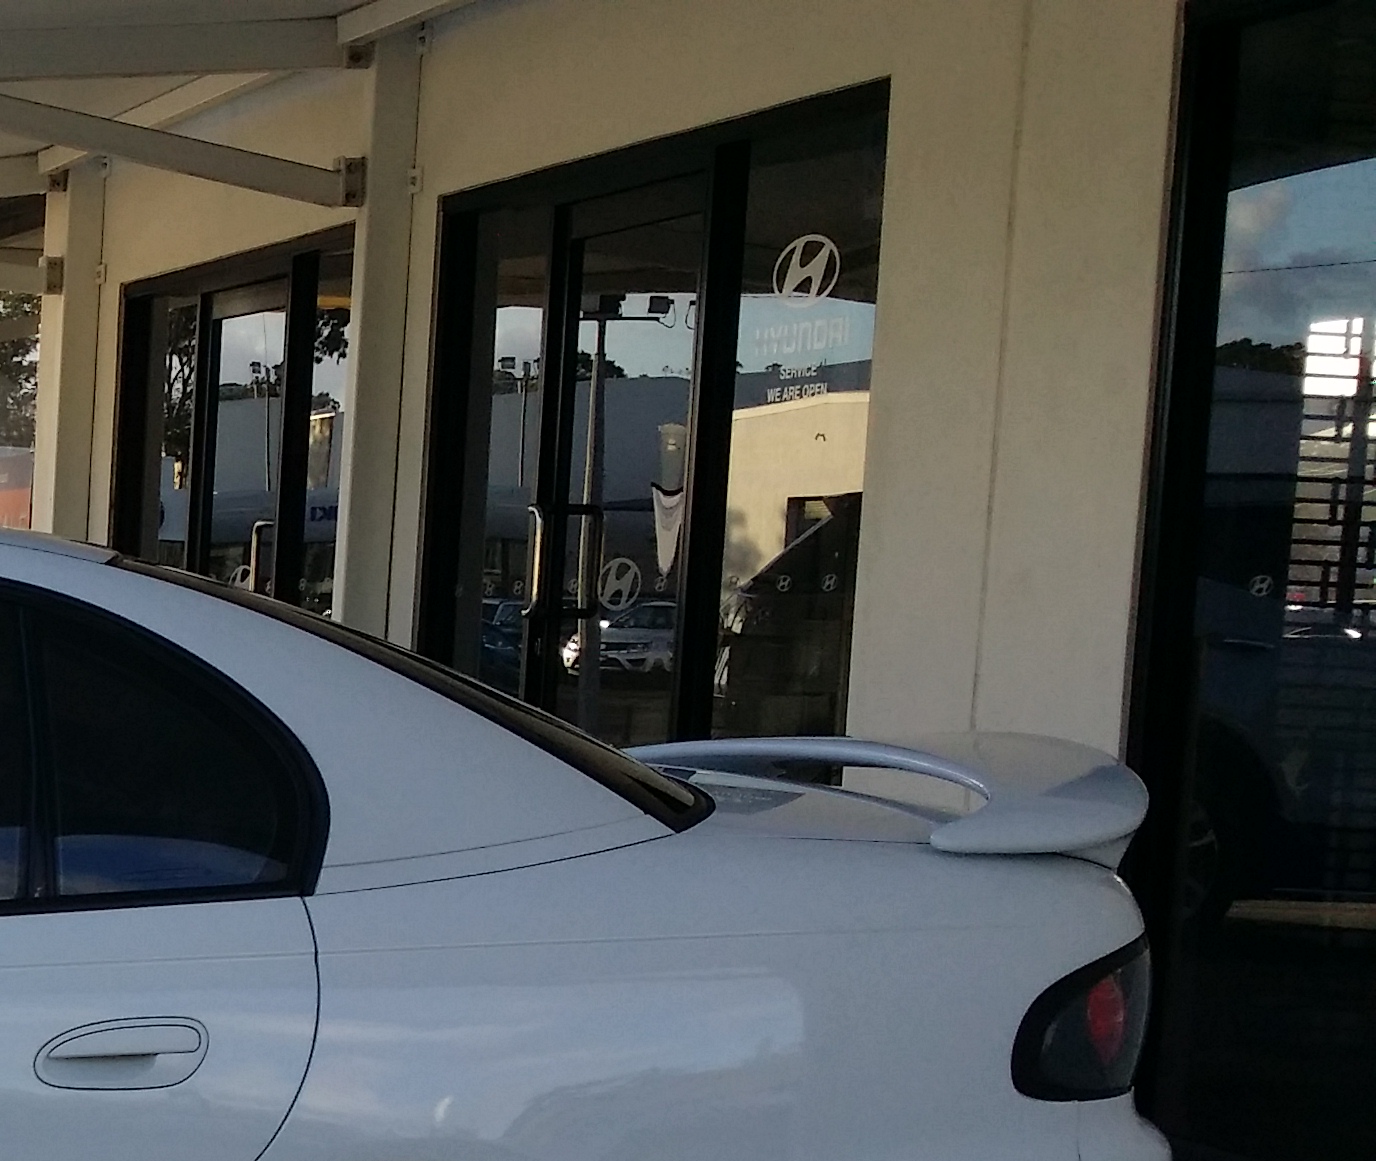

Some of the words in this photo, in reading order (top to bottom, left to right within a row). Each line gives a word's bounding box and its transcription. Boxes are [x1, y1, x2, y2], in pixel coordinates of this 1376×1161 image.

[779, 364, 818, 380] SERVICE
[766, 387, 782, 403] WE
[783, 384, 802, 401] ARE
[802, 382, 829, 399] OPEN
